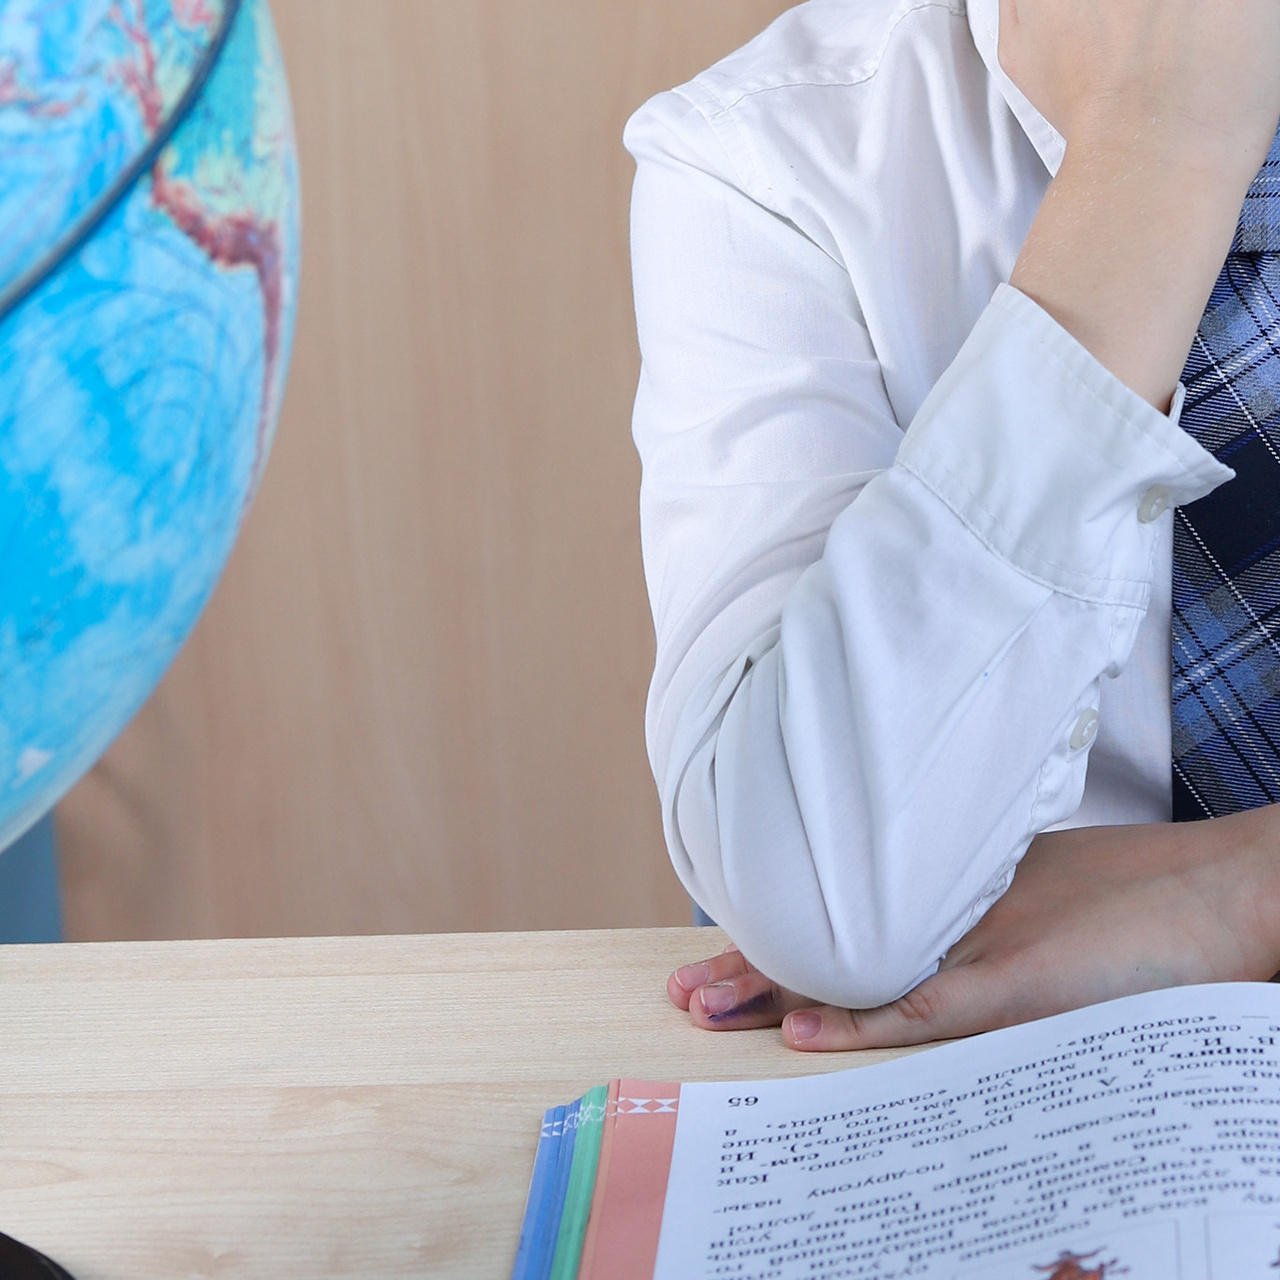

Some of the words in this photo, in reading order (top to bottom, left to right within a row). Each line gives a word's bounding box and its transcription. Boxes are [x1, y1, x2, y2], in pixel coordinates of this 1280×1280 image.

[1131, 1024, 1242, 1043] самовар
[1192, 1037, 1222, 1047] И.
[1248, 1035, 1275, 1046] В.
[1100, 1041, 1169, 1062] Даля
[1169, 1046, 1264, 1059] варить
[976, 1044, 1104, 1085] называли
[1037, 1062, 1076, 1079] мы
[1132, 1058, 1145, 1067] в
[984, 1066, 1108, 1106] значении
[1097, 1075, 1120, 1087] А
[728, 1096, 759, 1108] 65
[913, 1078, 1014, 1112] узнаём,
[984, 1086, 1073, 1117] просто
[1041, 1081, 1153, 1113] исконно
[1129, 1085, 1259, 1105] самовары.
[845, 1115, 889, 1129] что
[911, 1113, 1013, 1148] русское
[1033, 1107, 1156, 1141] Расскажи,
[1112, 1123, 1193, 1142] тепло
[721, 1126, 823, 1149] раньше
[724, 1129, 738, 1137] а
[844, 1119, 962, 1153] сложили
[1132, 1136, 1181, 1151] она
[720, 1151, 757, 1162] Из
[969, 1144, 1008, 1162] как
[1078, 1142, 1091, 1152] в
[720, 1165, 735, 1174] и
[759, 1153, 820, 1168] сам-
[800, 1150, 884, 1172] слово.
[717, 1173, 769, 1187] Как
[806, 1162, 945, 1200] по-другому
[932, 1151, 1058, 1192] самоваре
[959, 1153, 1097, 1195] закипала.
[1028, 1155, 1146, 1191] Самовар
[713, 1198, 782, 1214] назы-
[834, 1191, 913, 1213] очень
[880, 1194, 996, 1230] начинал
[1083, 1195, 1135, 1214] или
[1122, 1197, 1208, 1218] клали
[728, 1210, 816, 1237] долго!
[808, 1201, 920, 1232] Горячие
[981, 1198, 1068, 1230] Потом
[706, 1231, 846, 1261] нагревать
[710, 1230, 772, 1250] угли
[769, 1209, 988, 1266] напоминающей
[958, 1219, 1090, 1262] сосновые
[810, 1229, 954, 1271] раздували
